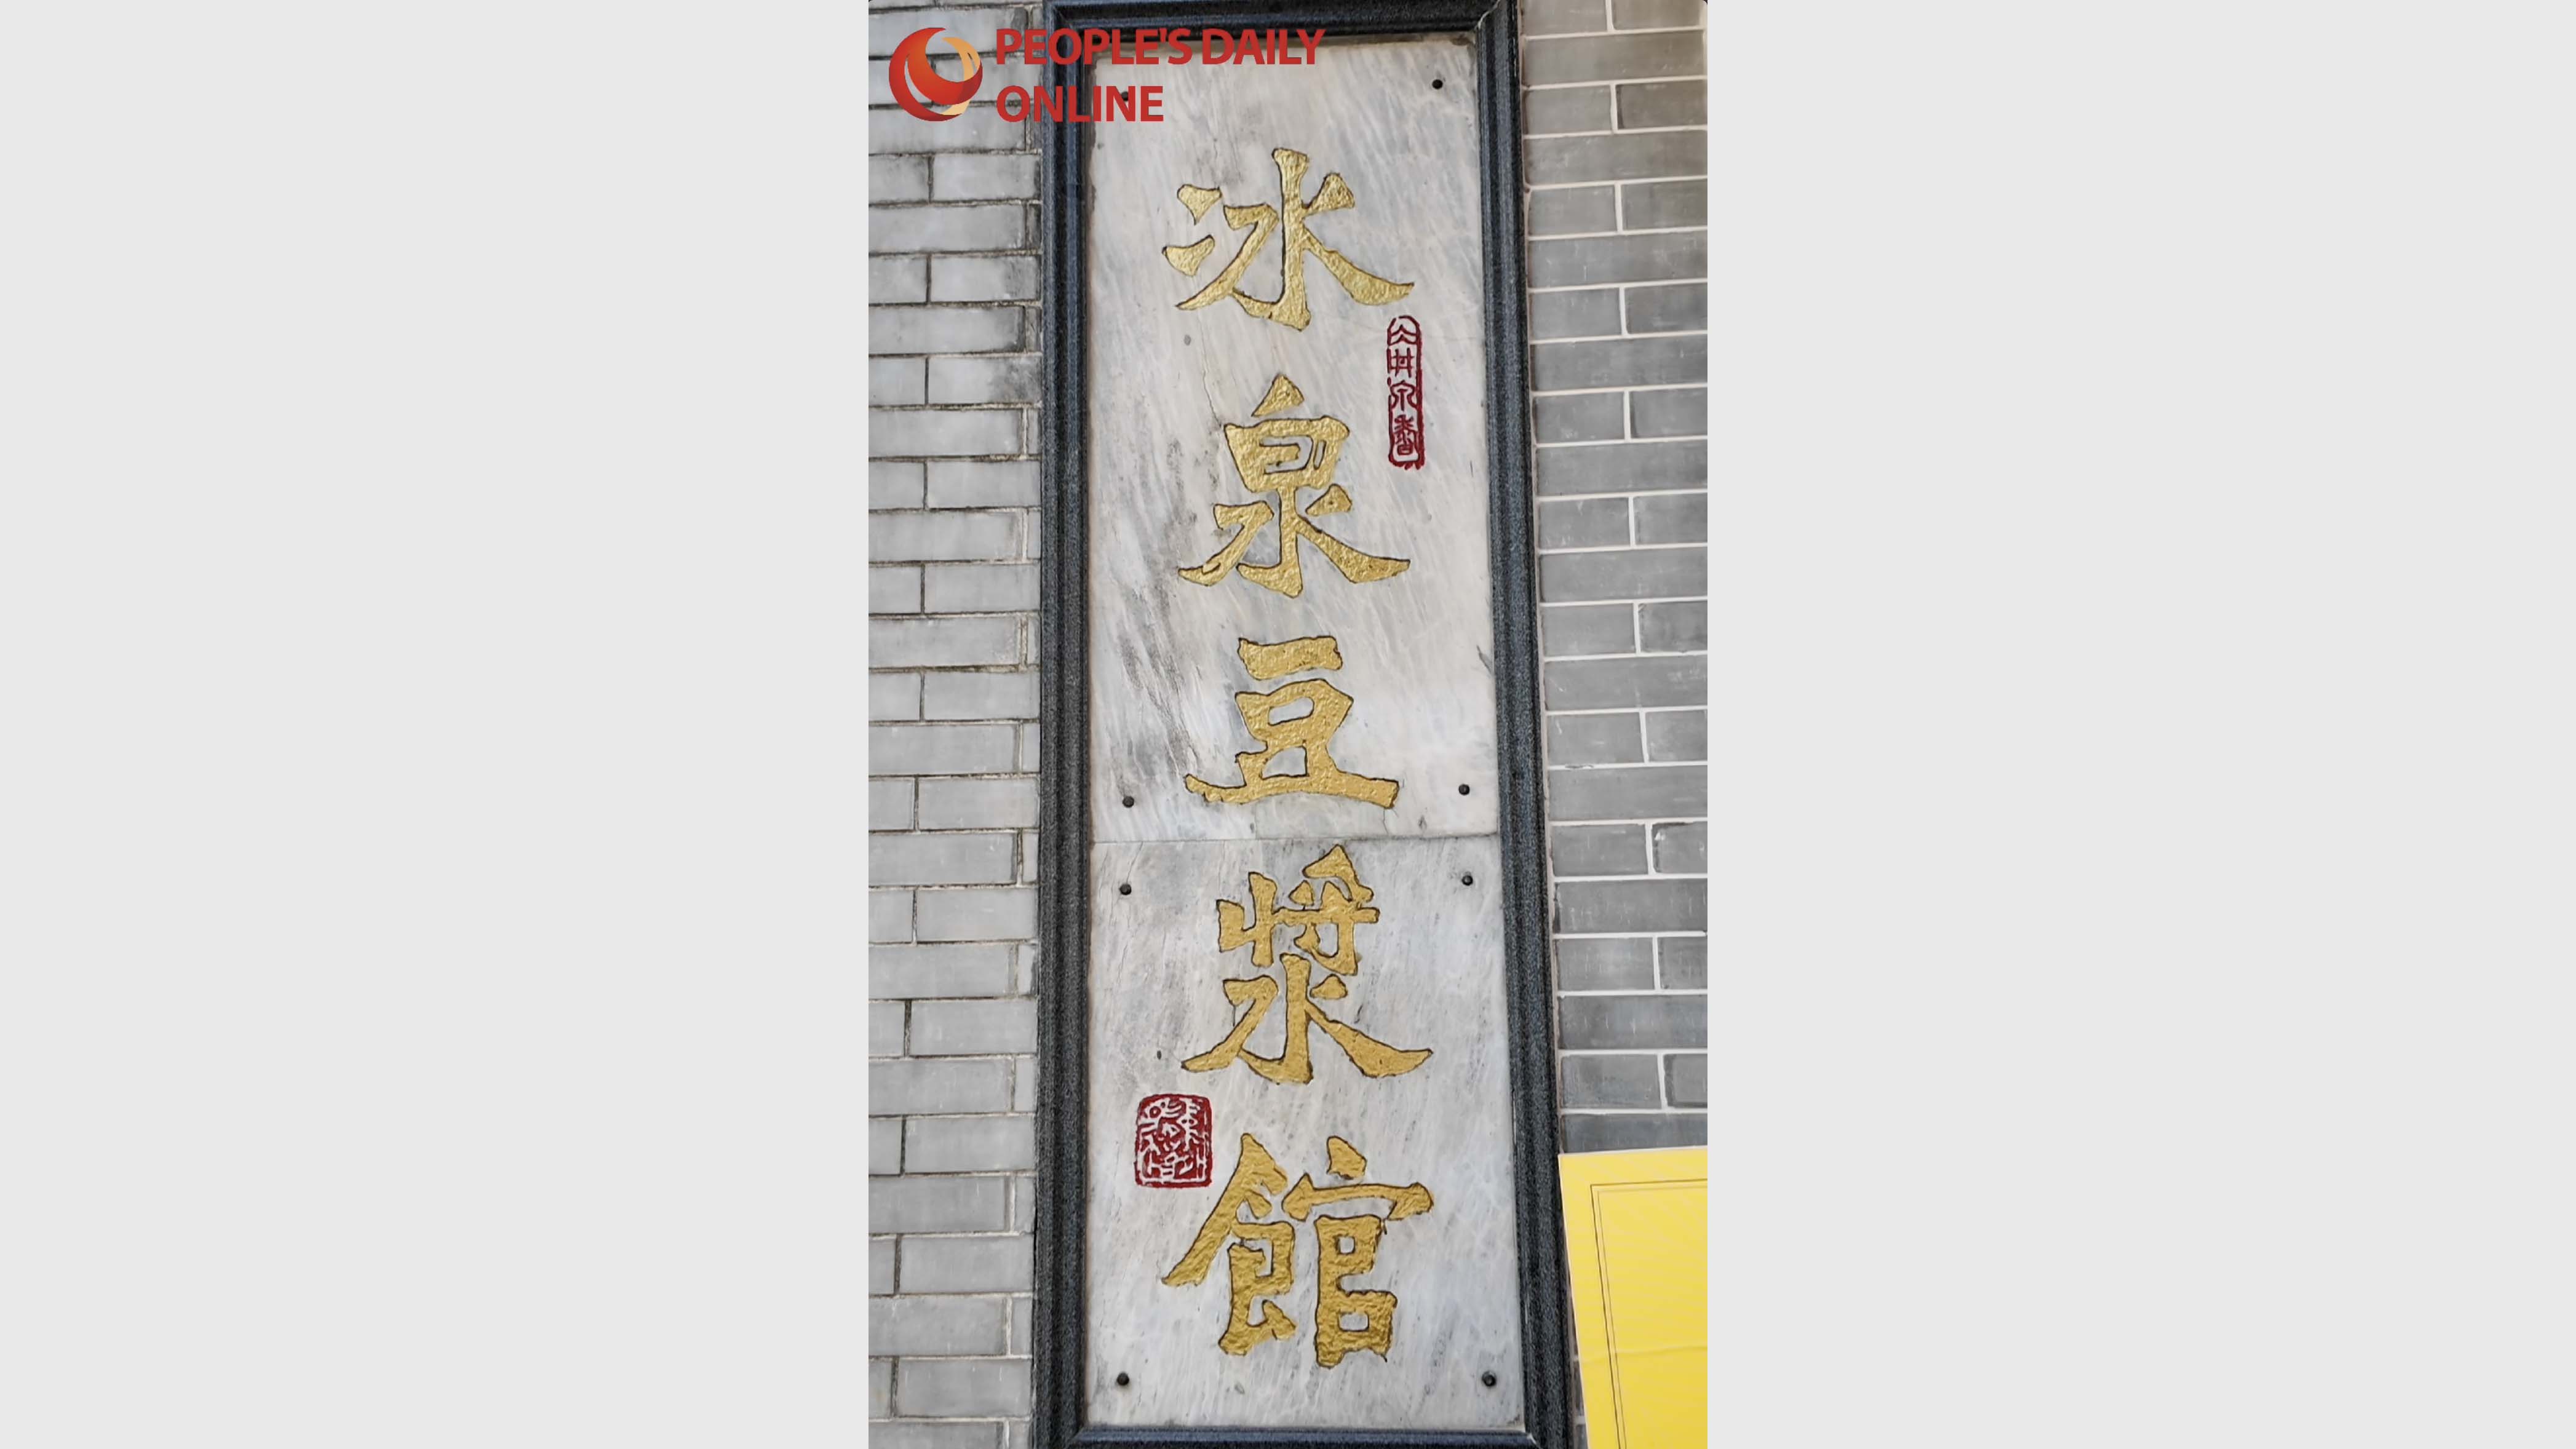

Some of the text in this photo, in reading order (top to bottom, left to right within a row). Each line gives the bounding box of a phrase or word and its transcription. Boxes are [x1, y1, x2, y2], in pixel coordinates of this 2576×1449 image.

[1161, 147, 1434, 1369] 冰泉豆漿館
